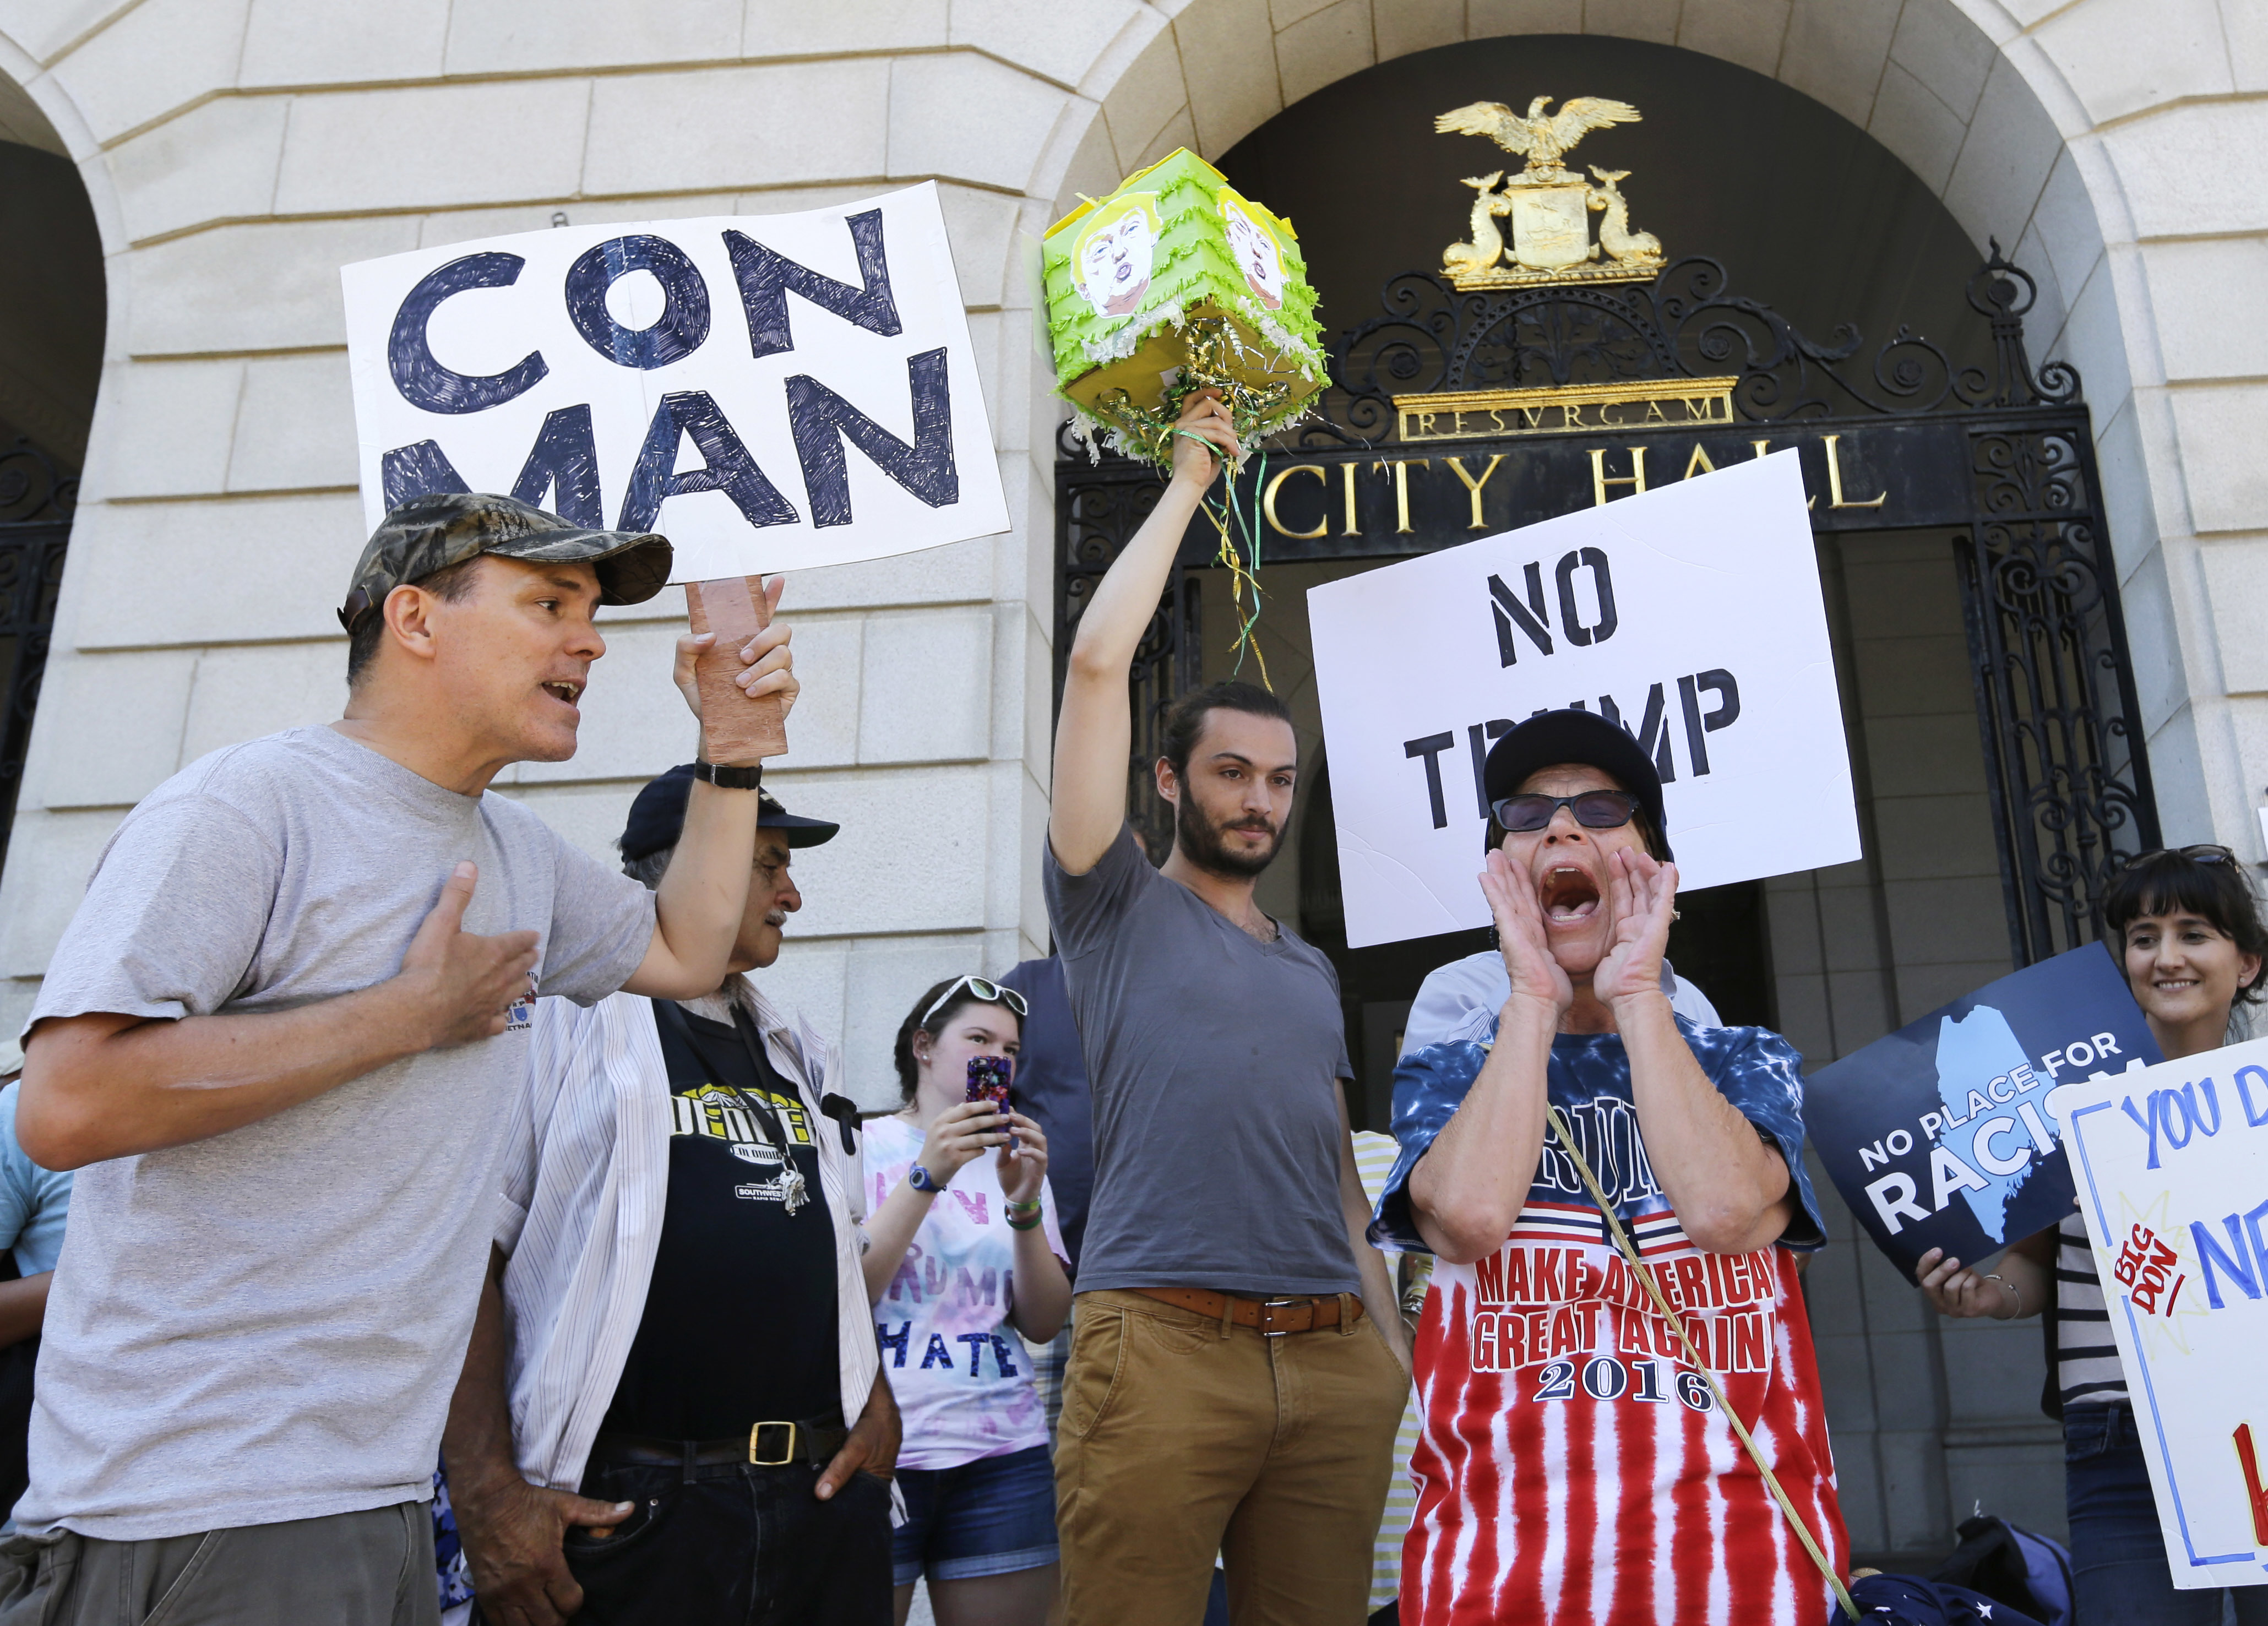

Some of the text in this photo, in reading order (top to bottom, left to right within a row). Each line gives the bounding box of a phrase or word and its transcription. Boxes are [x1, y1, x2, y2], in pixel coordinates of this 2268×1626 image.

[388, 208, 902, 414] CON
[382, 347, 959, 531] MAN
[1418, 397, 1712, 435] RESVRGAM
[1263, 434, 1887, 539] CITY HL
[1487, 546, 1618, 668] NO
[1858, 1032, 2122, 1172] NO PLACE FOR
[2121, 1076, 2222, 1170] YOU
[1864, 1057, 2147, 1235] RACI
[1474, 1247, 1776, 1318] MAKE AMERICA
[2114, 1222, 2155, 1288] BIG
[2131, 1238, 2178, 1315] DON
[878, 1320, 1018, 1378] HATE
[1471, 1301, 1606, 1373] GREAT
[1532, 1355, 1714, 1412] 2016
